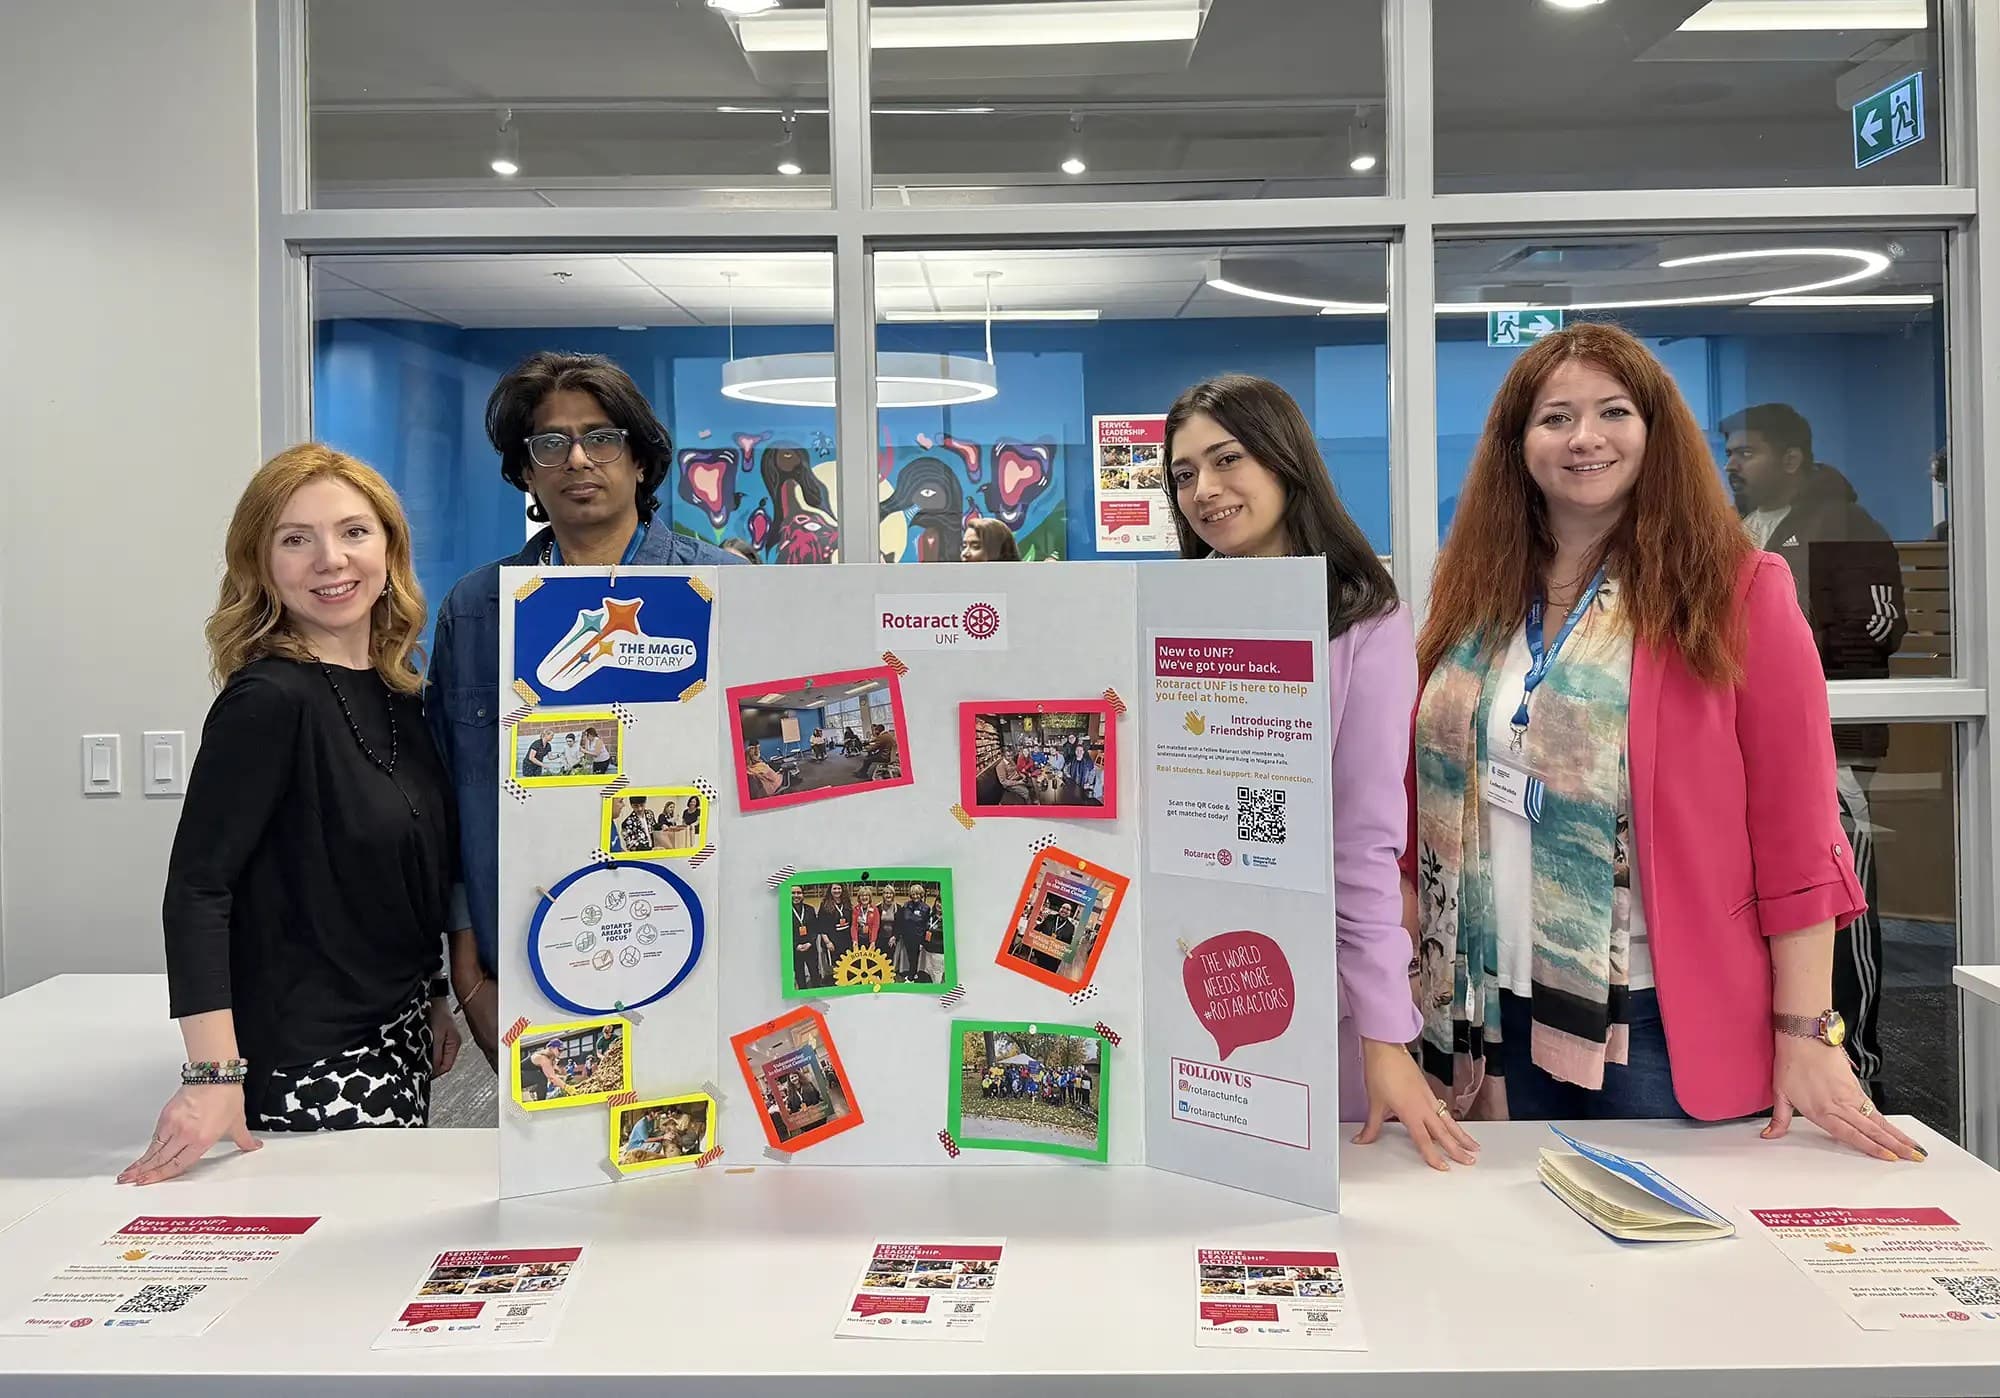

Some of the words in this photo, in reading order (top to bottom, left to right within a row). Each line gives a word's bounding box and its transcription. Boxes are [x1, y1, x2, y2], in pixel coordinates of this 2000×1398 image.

[1101, 421, 1132, 429] SERVICE.
[1101, 428, 1148, 436] LEADERSHIP.
[881, 612, 959, 629] Rotaract
[935, 633, 960, 644] UNF
[619, 642, 646, 655] THE
[648, 643, 694, 656] MAGIC
[1159, 646, 1186, 657] New
[1188, 646, 1201, 657] to
[1203, 647, 1235, 658] UNF?
[618, 655, 635, 666] OF
[637, 655, 684, 667] ROTARY
[1159, 658, 1194, 670] We've
[1195, 661, 1215, 674] got
[1217, 661, 1246, 674] your
[1248, 660, 1281, 674] back.
[1156, 678, 1202, 690] Rotaract
[1203, 680, 1227, 691] UNF
[1230, 680, 1239, 691] is
[1241, 681, 1266, 693] here
[1268, 683, 1280, 693] to
[1282, 682, 1308, 697] help
[1155, 691, 1176, 702] you
[1178, 690, 1198, 702] feel
[1200, 693, 1212, 703] at
[1214, 692, 1248, 704] home.
[1231, 714, 1292, 730] Introducing
[1294, 717, 1313, 729] the
[1210, 724, 1265, 740] Friendship
[1267, 728, 1313, 742] Program
[1156, 764, 1171, 772] Real
[1172, 766, 1205, 775] students.
[1206, 767, 1222, 776] Real
[1223, 769, 1252, 779] support.
[1254, 771, 1270, 780] Real
[1271, 773, 1314, 784] connection.
[1184, 800, 1196, 808] the
[1196, 801, 1207, 809] QR
[1207, 802, 1224, 810] Code
[1166, 809, 1177, 817] get
[1178, 810, 1207, 819] matched
[1207, 812, 1229, 822] today!
[1183, 848, 1216, 860] Rotaract
[601, 922, 633, 931] ROTARY'S
[601, 928, 623, 936] AREAS
[623, 927, 633, 935] OF
[606, 934, 628, 942] FOCUS
[1200, 952, 1223, 974] THE
[1222, 944, 1262, 969] WORLD
[1203, 972, 1241, 998] NEEDS
[1240, 966, 1273, 991] MORE
[1204, 987, 1289, 1021] #ROTARACTORS
[1178, 1062, 1233, 1085] FOLLOW
[1234, 1073, 1253, 1089] US
